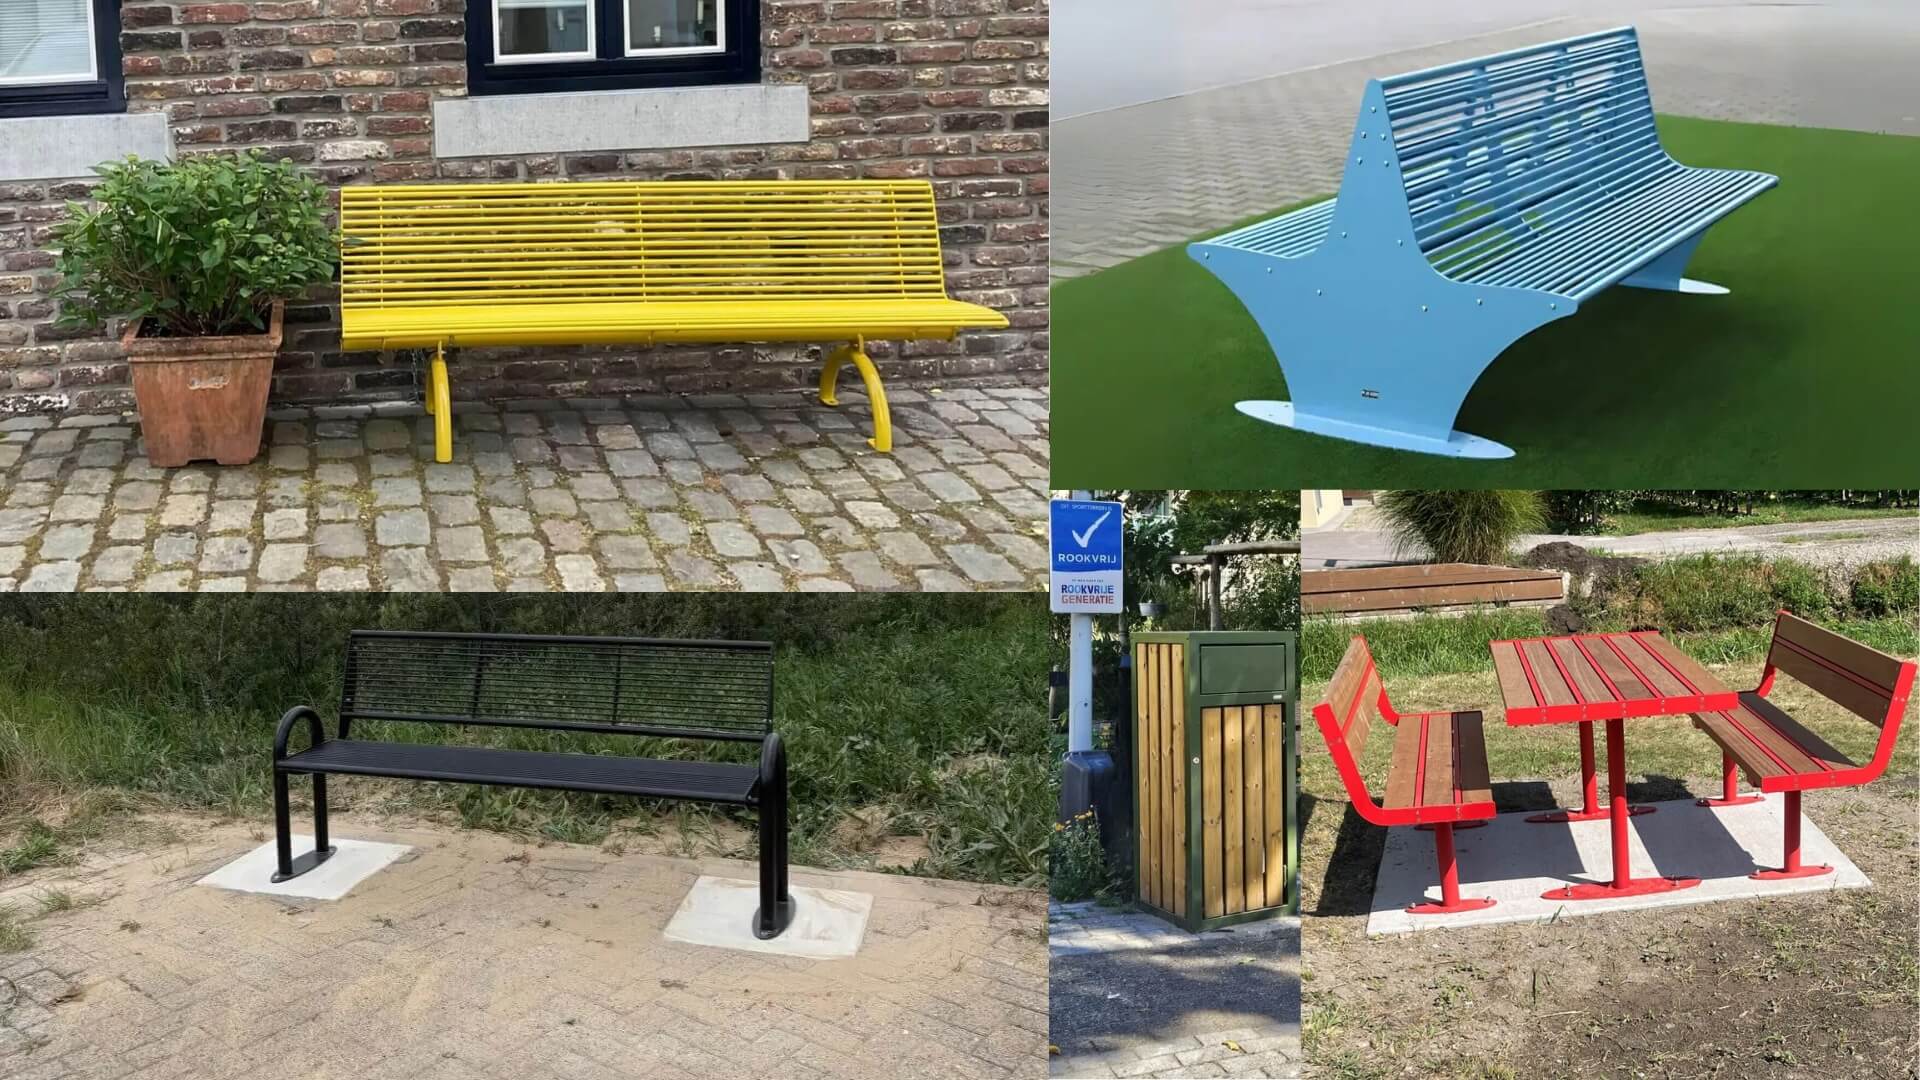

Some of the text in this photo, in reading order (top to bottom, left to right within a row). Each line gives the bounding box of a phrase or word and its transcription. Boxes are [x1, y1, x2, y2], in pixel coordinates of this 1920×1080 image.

[1058, 553, 1116, 564] ROOKVRIJ
[1061, 584, 1114, 594] ROOKVRIJE
[1061, 595, 1114, 604] GENERATIE
